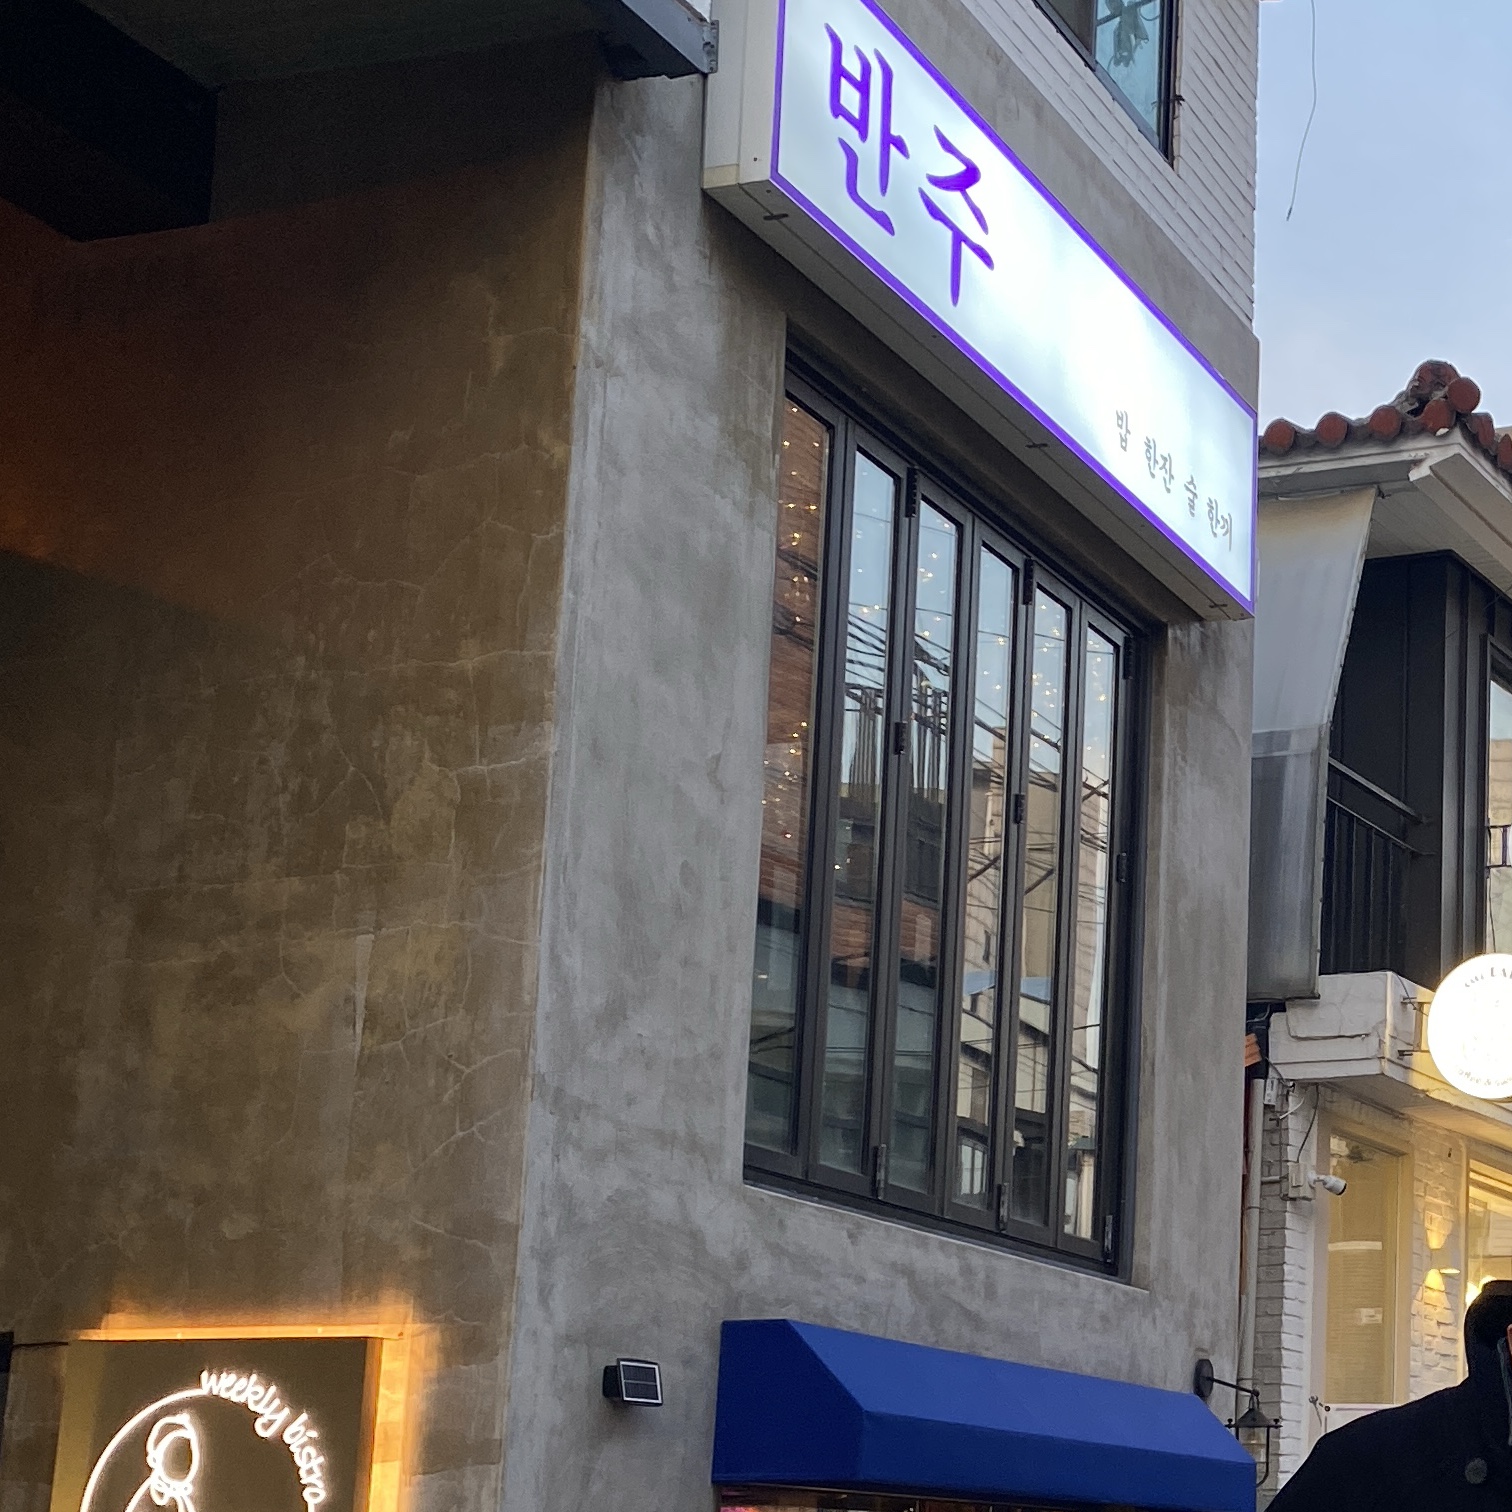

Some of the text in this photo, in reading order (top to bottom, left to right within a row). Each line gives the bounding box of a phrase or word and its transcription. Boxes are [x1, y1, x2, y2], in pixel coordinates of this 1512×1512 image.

[824, 22, 995, 307] 반주
[1115, 409, 1233, 552] 밥 한잔 술 한끼
[200, 1369, 326, 1505] weekly bistro
